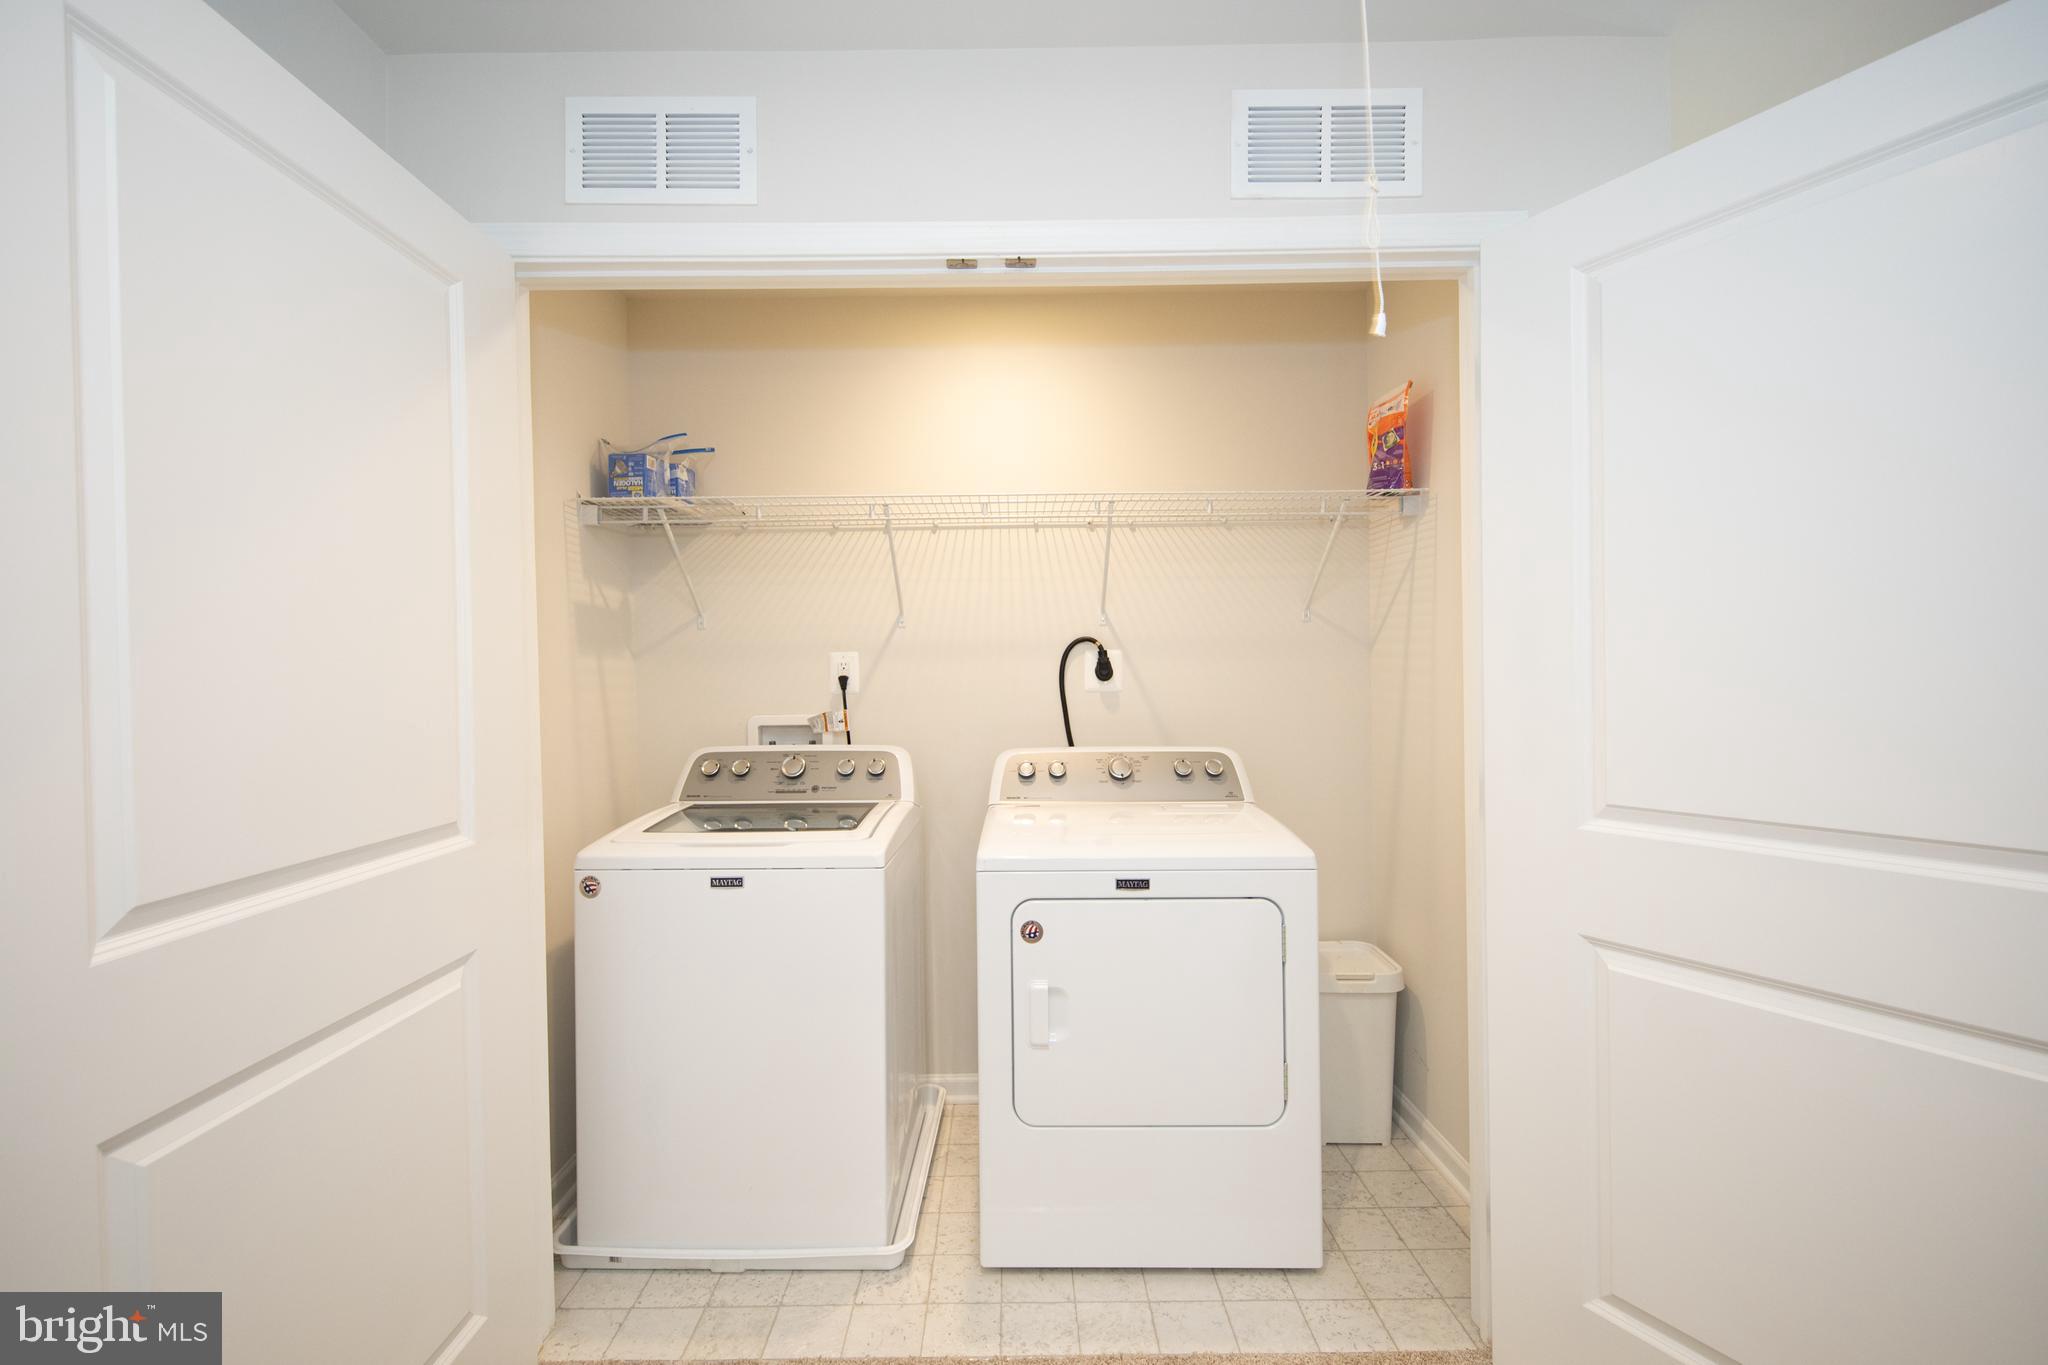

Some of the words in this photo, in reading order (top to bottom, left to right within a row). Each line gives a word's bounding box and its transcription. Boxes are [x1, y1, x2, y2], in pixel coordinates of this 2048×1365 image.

[613, 479, 643, 487] HALOGEN
[711, 878, 743, 887] MAYTAG
[1117, 880, 1149, 888] MAYTAG
